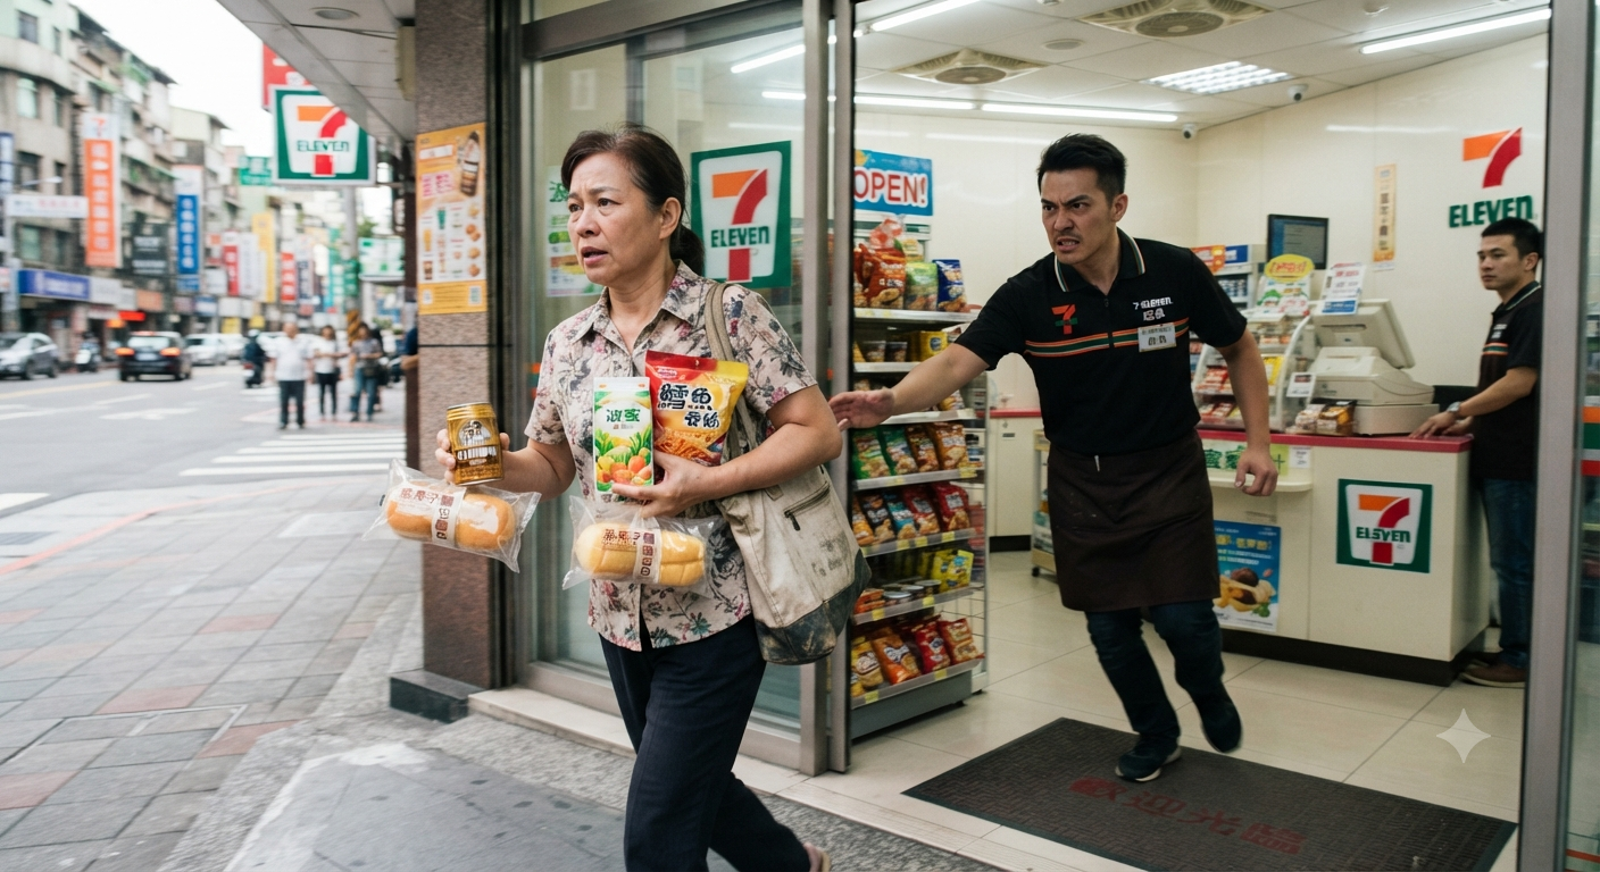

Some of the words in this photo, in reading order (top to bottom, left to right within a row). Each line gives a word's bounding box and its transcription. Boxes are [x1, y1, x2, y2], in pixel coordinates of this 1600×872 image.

[854, 170, 927, 204] OPEN!
[1463, 127, 1522, 188] 7
[712, 169, 767, 281] 7
[1358, 494, 1410, 564] 7
